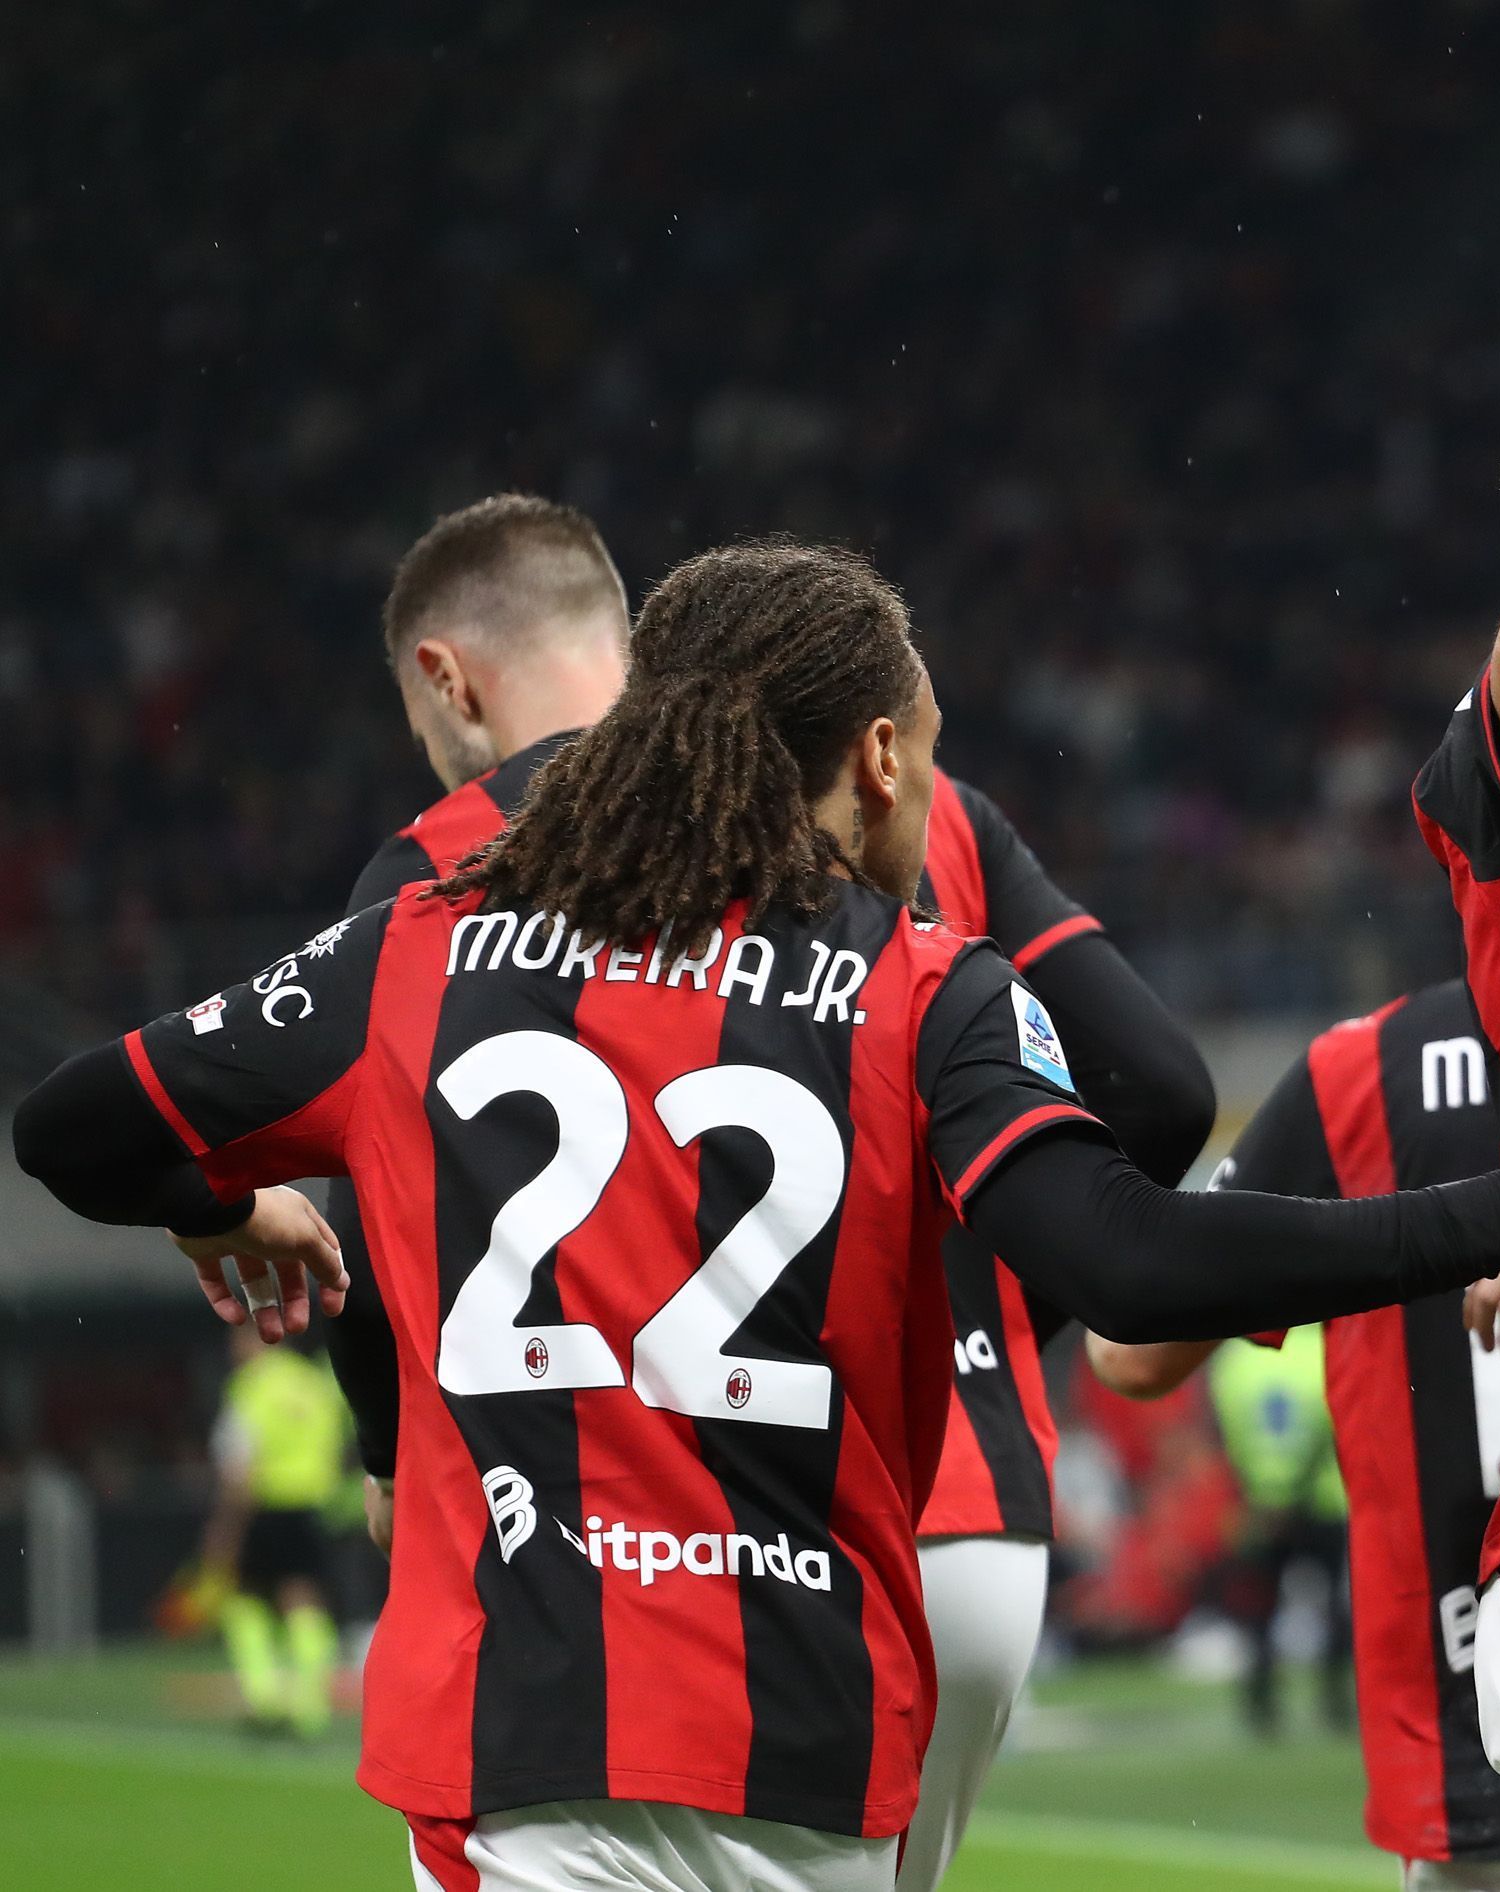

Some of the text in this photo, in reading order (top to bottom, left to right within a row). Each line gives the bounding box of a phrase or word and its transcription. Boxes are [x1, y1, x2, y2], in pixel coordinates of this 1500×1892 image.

[252, 953, 315, 1028] SC
[780, 939, 868, 1025] JR.
[1026, 1033, 1052, 1055] SERIE
[437, 1030, 846, 1431] 22
